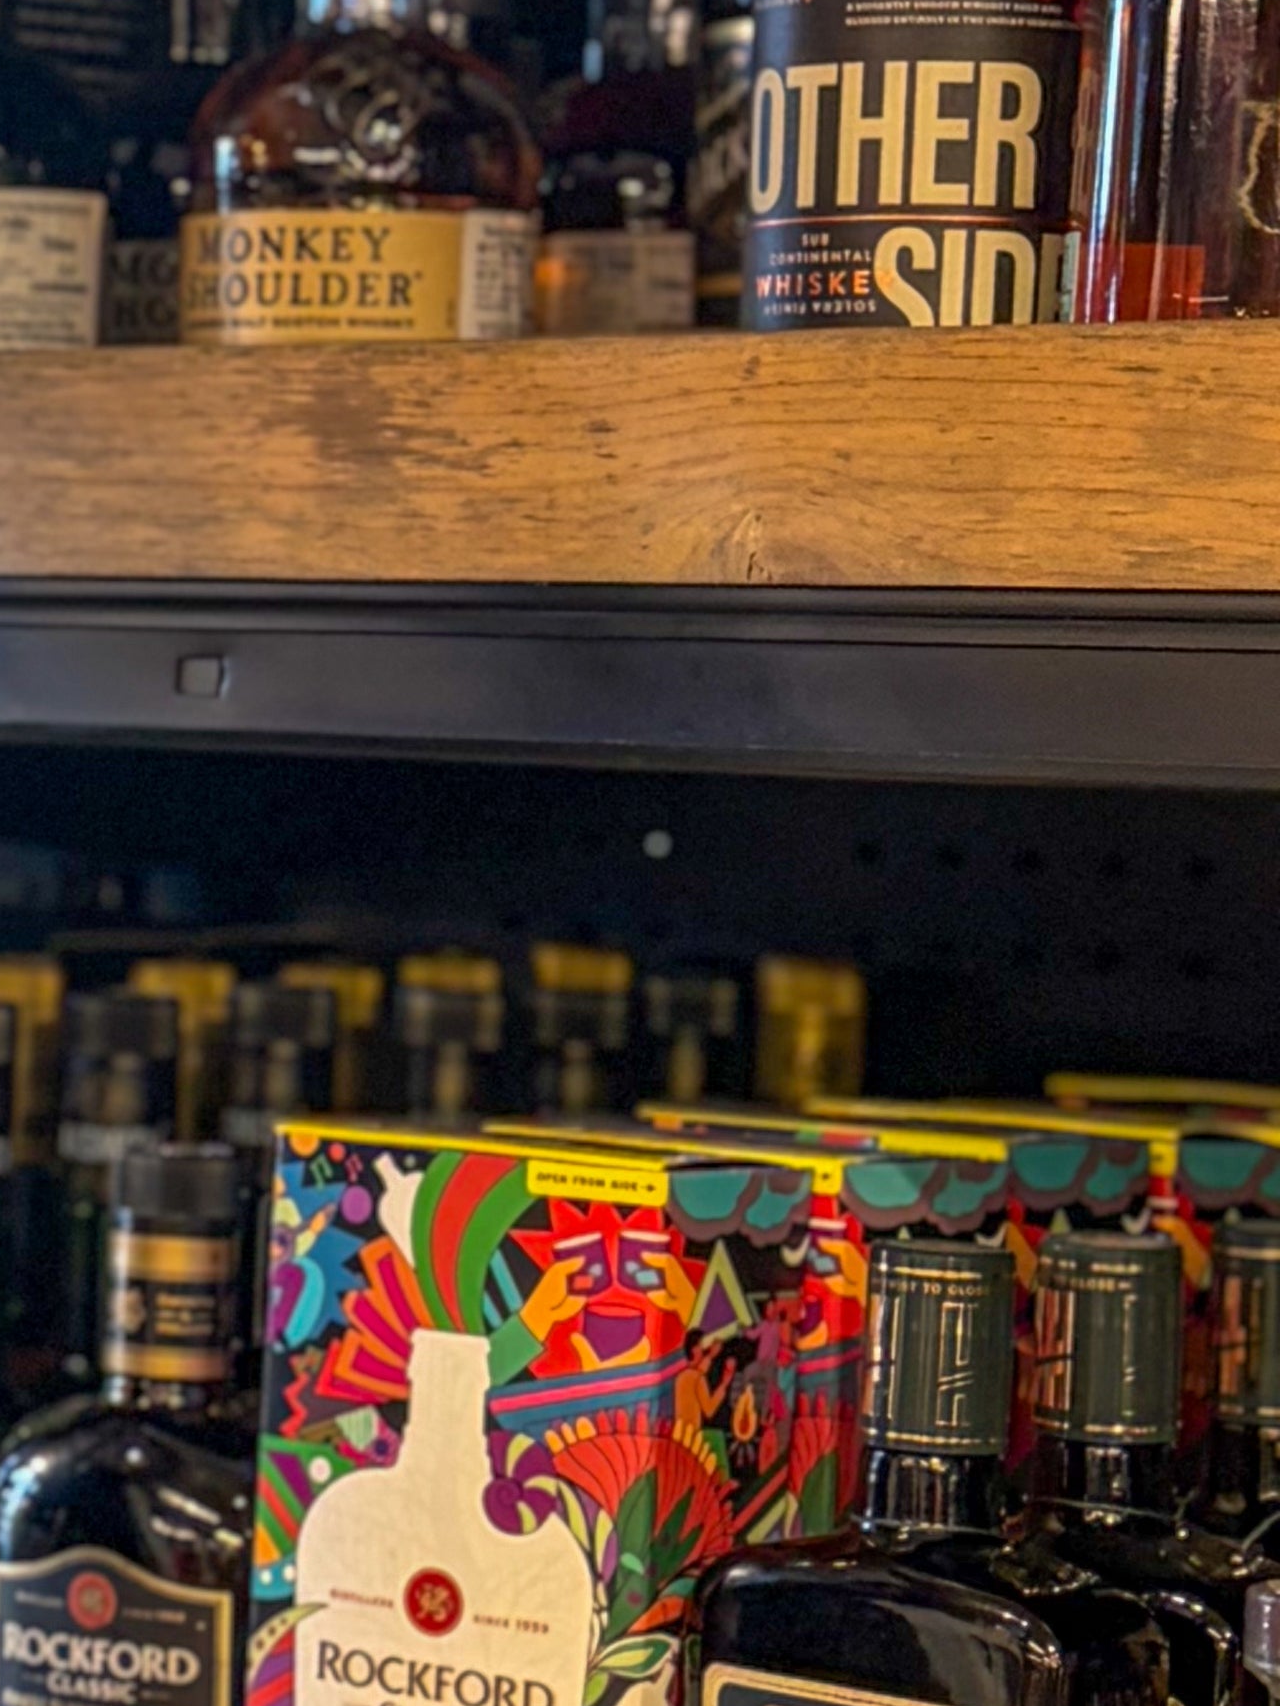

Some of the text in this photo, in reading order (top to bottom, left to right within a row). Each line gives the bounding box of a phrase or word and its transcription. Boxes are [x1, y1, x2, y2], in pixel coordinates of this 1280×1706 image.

[750, 60, 1042, 215] OTHER
[195, 225, 392, 265] MONKEY
[801, 233, 830, 248] SUB
[768, 247, 873, 267] CONTINENTAL
[536, 1170, 639, 1194] OPEN FROM SIDE
[1, 1620, 201, 1686] ROCKFORD
